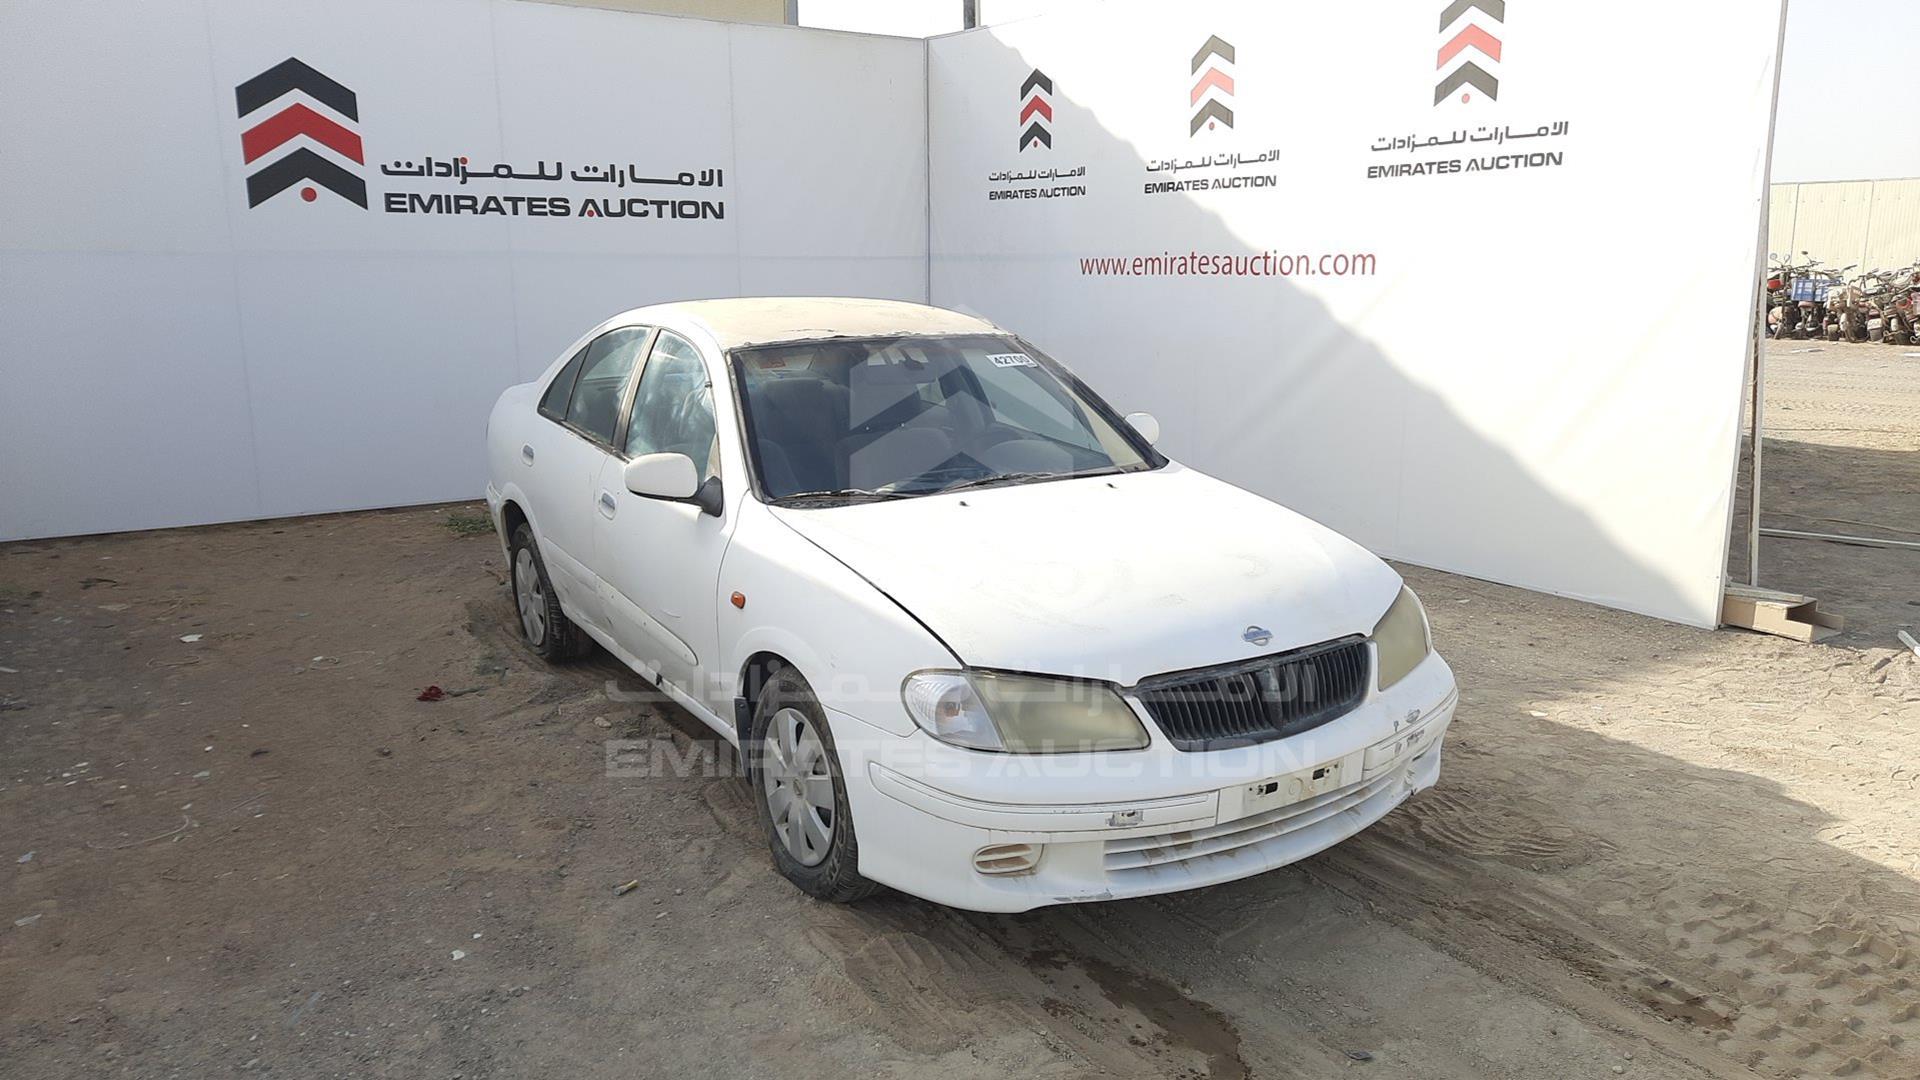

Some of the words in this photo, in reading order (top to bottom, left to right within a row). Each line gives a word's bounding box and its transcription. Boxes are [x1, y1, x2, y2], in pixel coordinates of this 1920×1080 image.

[1370, 130, 1467, 153] للمزادات
[1470, 121, 1569, 145] الامارات
[380, 156, 564, 185] للمزادات
[571, 164, 724, 188] الامارات
[1367, 159, 1462, 179] EMIRATES
[1465, 151, 1564, 173] AUCTION
[988, 188, 1037, 201] EMIRATES
[1038, 185, 1087, 199] AUCTION
[1144, 178, 1209, 195] EMIRATES
[1211, 175, 1277, 191] AUCTION
[384, 192, 570, 218] EMIRATES
[578, 198, 725, 220] AUCTION
[1080, 250, 1377, 276] www.emiratesauction.com
